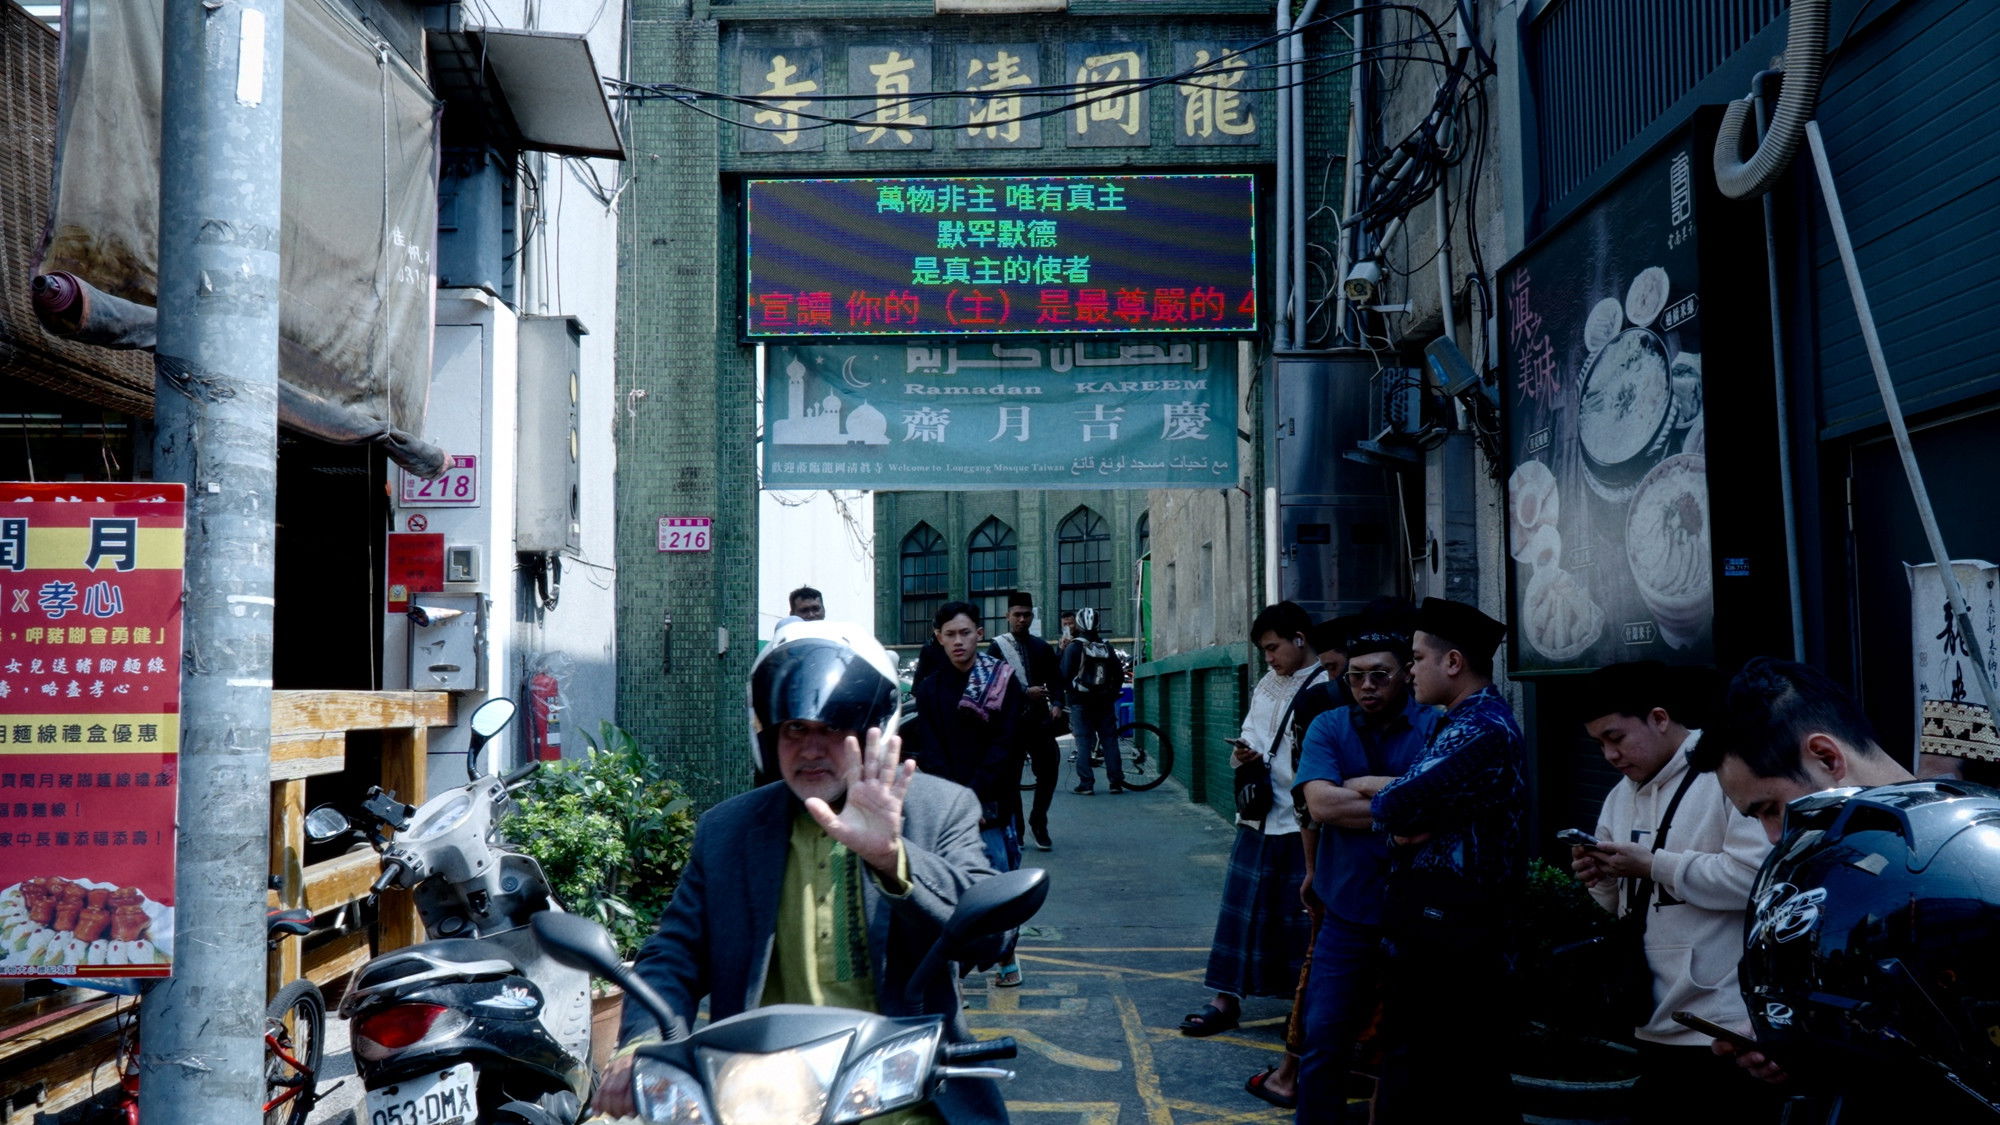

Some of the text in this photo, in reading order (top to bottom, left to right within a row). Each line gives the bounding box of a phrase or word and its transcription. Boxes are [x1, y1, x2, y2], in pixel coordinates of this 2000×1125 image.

[755, 49, 1257, 145] 龍岡清真寺
[876, 182, 1127, 213] 萬物非主 唯有真主
[937, 219, 1058, 249] 默罕默德
[911, 255, 1091, 285] 是真主的使者
[759, 290, 832, 327] 宣讀
[904, 379, 1209, 395] Ramadan KAREEM
[888, 463, 1065, 475] Welcome to Longgang Mosque Taiwan
[1130, 456, 1165, 473] مسجد
[418, 475, 470, 498] 218
[669, 531, 706, 548] 216
[0, 627, 165, 645] ，呷豬腳會勇健」
